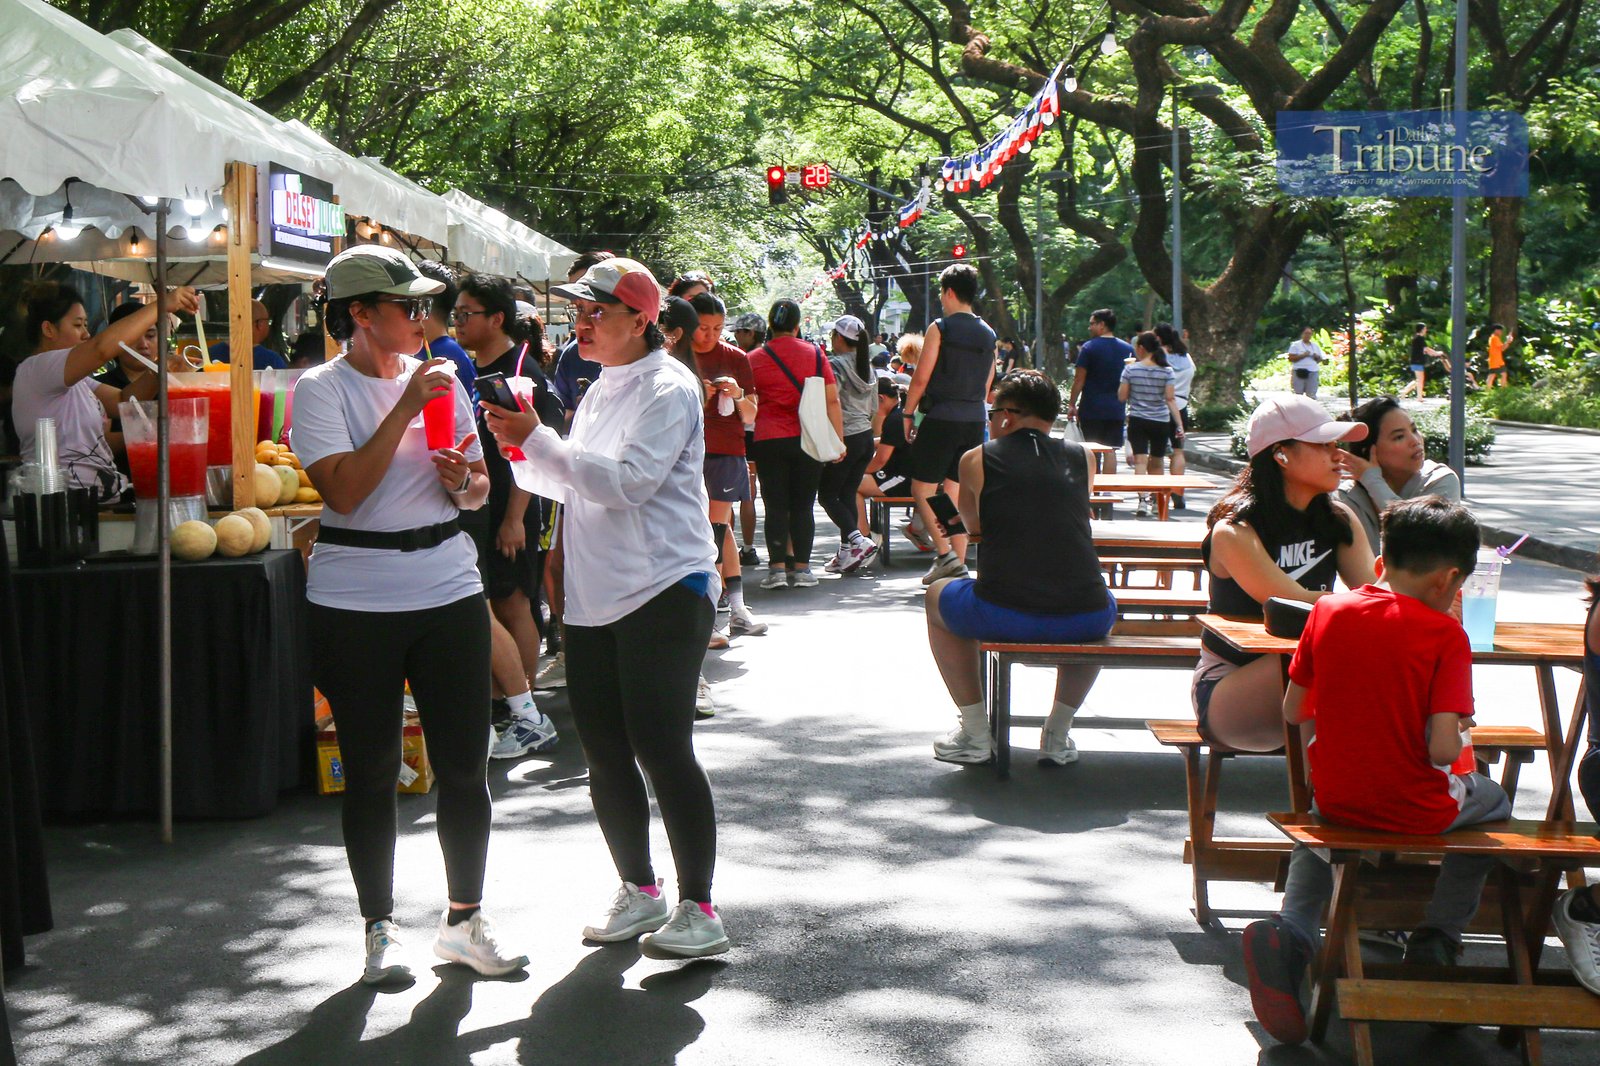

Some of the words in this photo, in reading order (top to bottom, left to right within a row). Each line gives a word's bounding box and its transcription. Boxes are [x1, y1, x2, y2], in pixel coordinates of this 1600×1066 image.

[805, 166, 828, 185] 28
[286, 191, 315, 230] DELSEY
[318, 199, 345, 236] JUICES
[1280, 540, 1315, 568] NIKE
